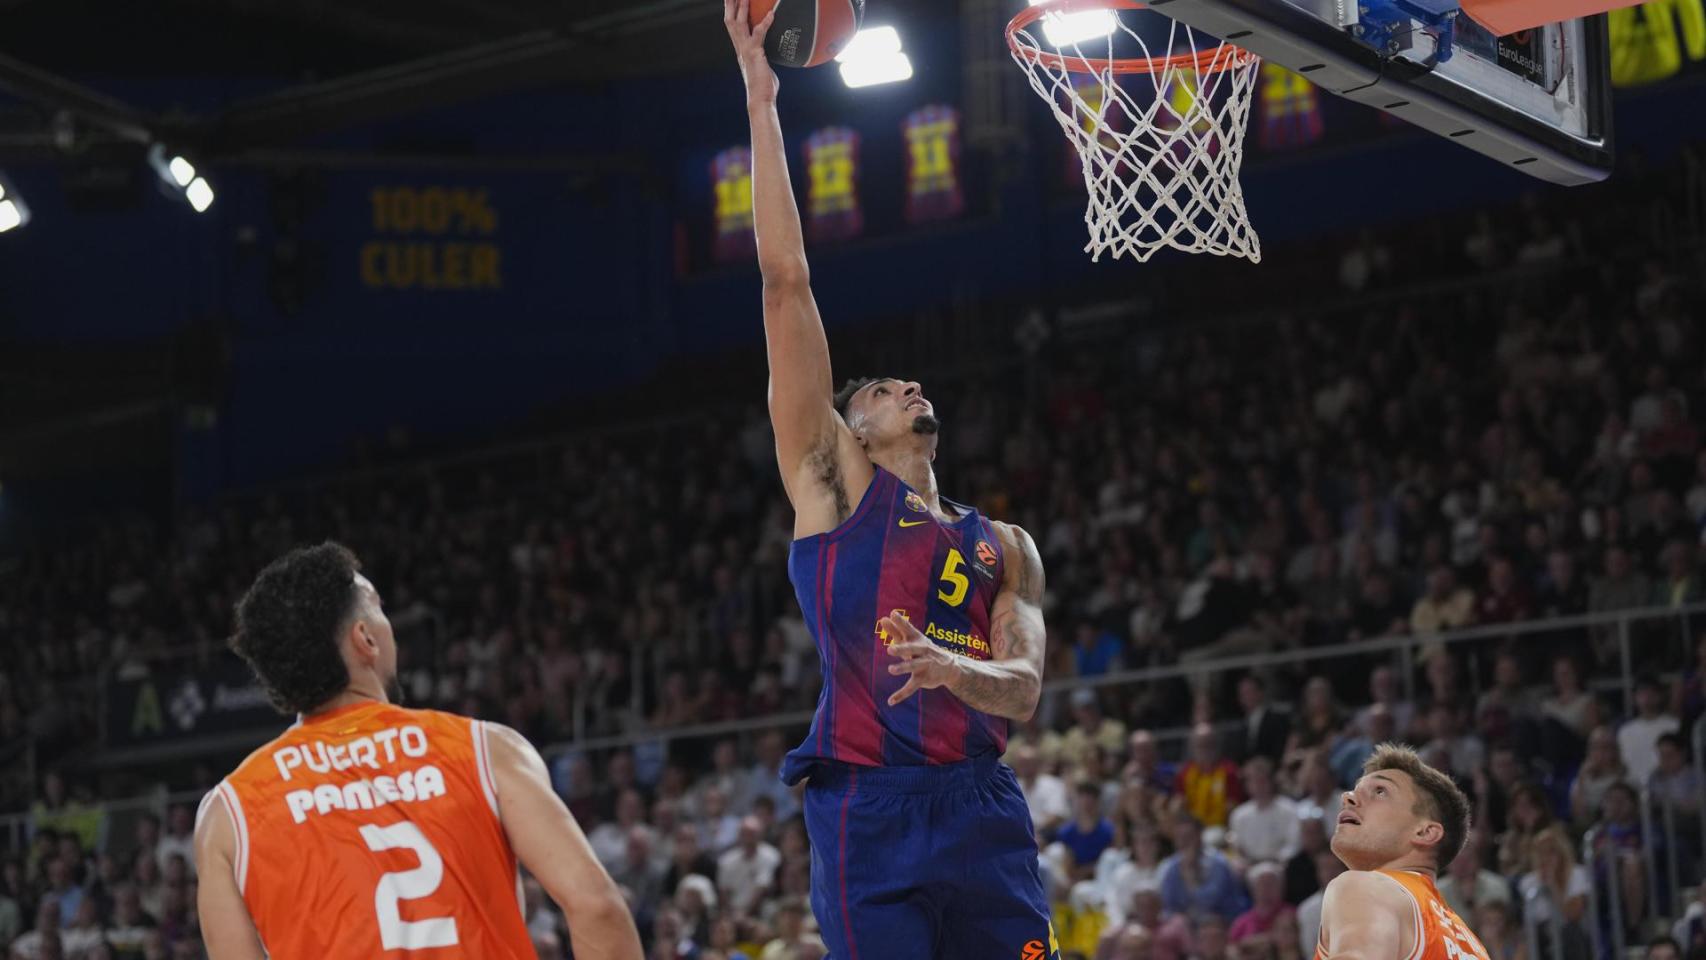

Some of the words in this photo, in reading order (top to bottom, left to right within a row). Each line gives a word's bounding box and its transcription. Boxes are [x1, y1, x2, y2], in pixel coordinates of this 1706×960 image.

[1497, 41, 1544, 74] EuroLeague
[370, 186, 497, 233] 100%
[360, 243, 502, 290] CULER
[937, 548, 970, 608] 5
[272, 725, 428, 782] PUERTO
[284, 764, 447, 825] PAMESA
[358, 820, 459, 951] 2
